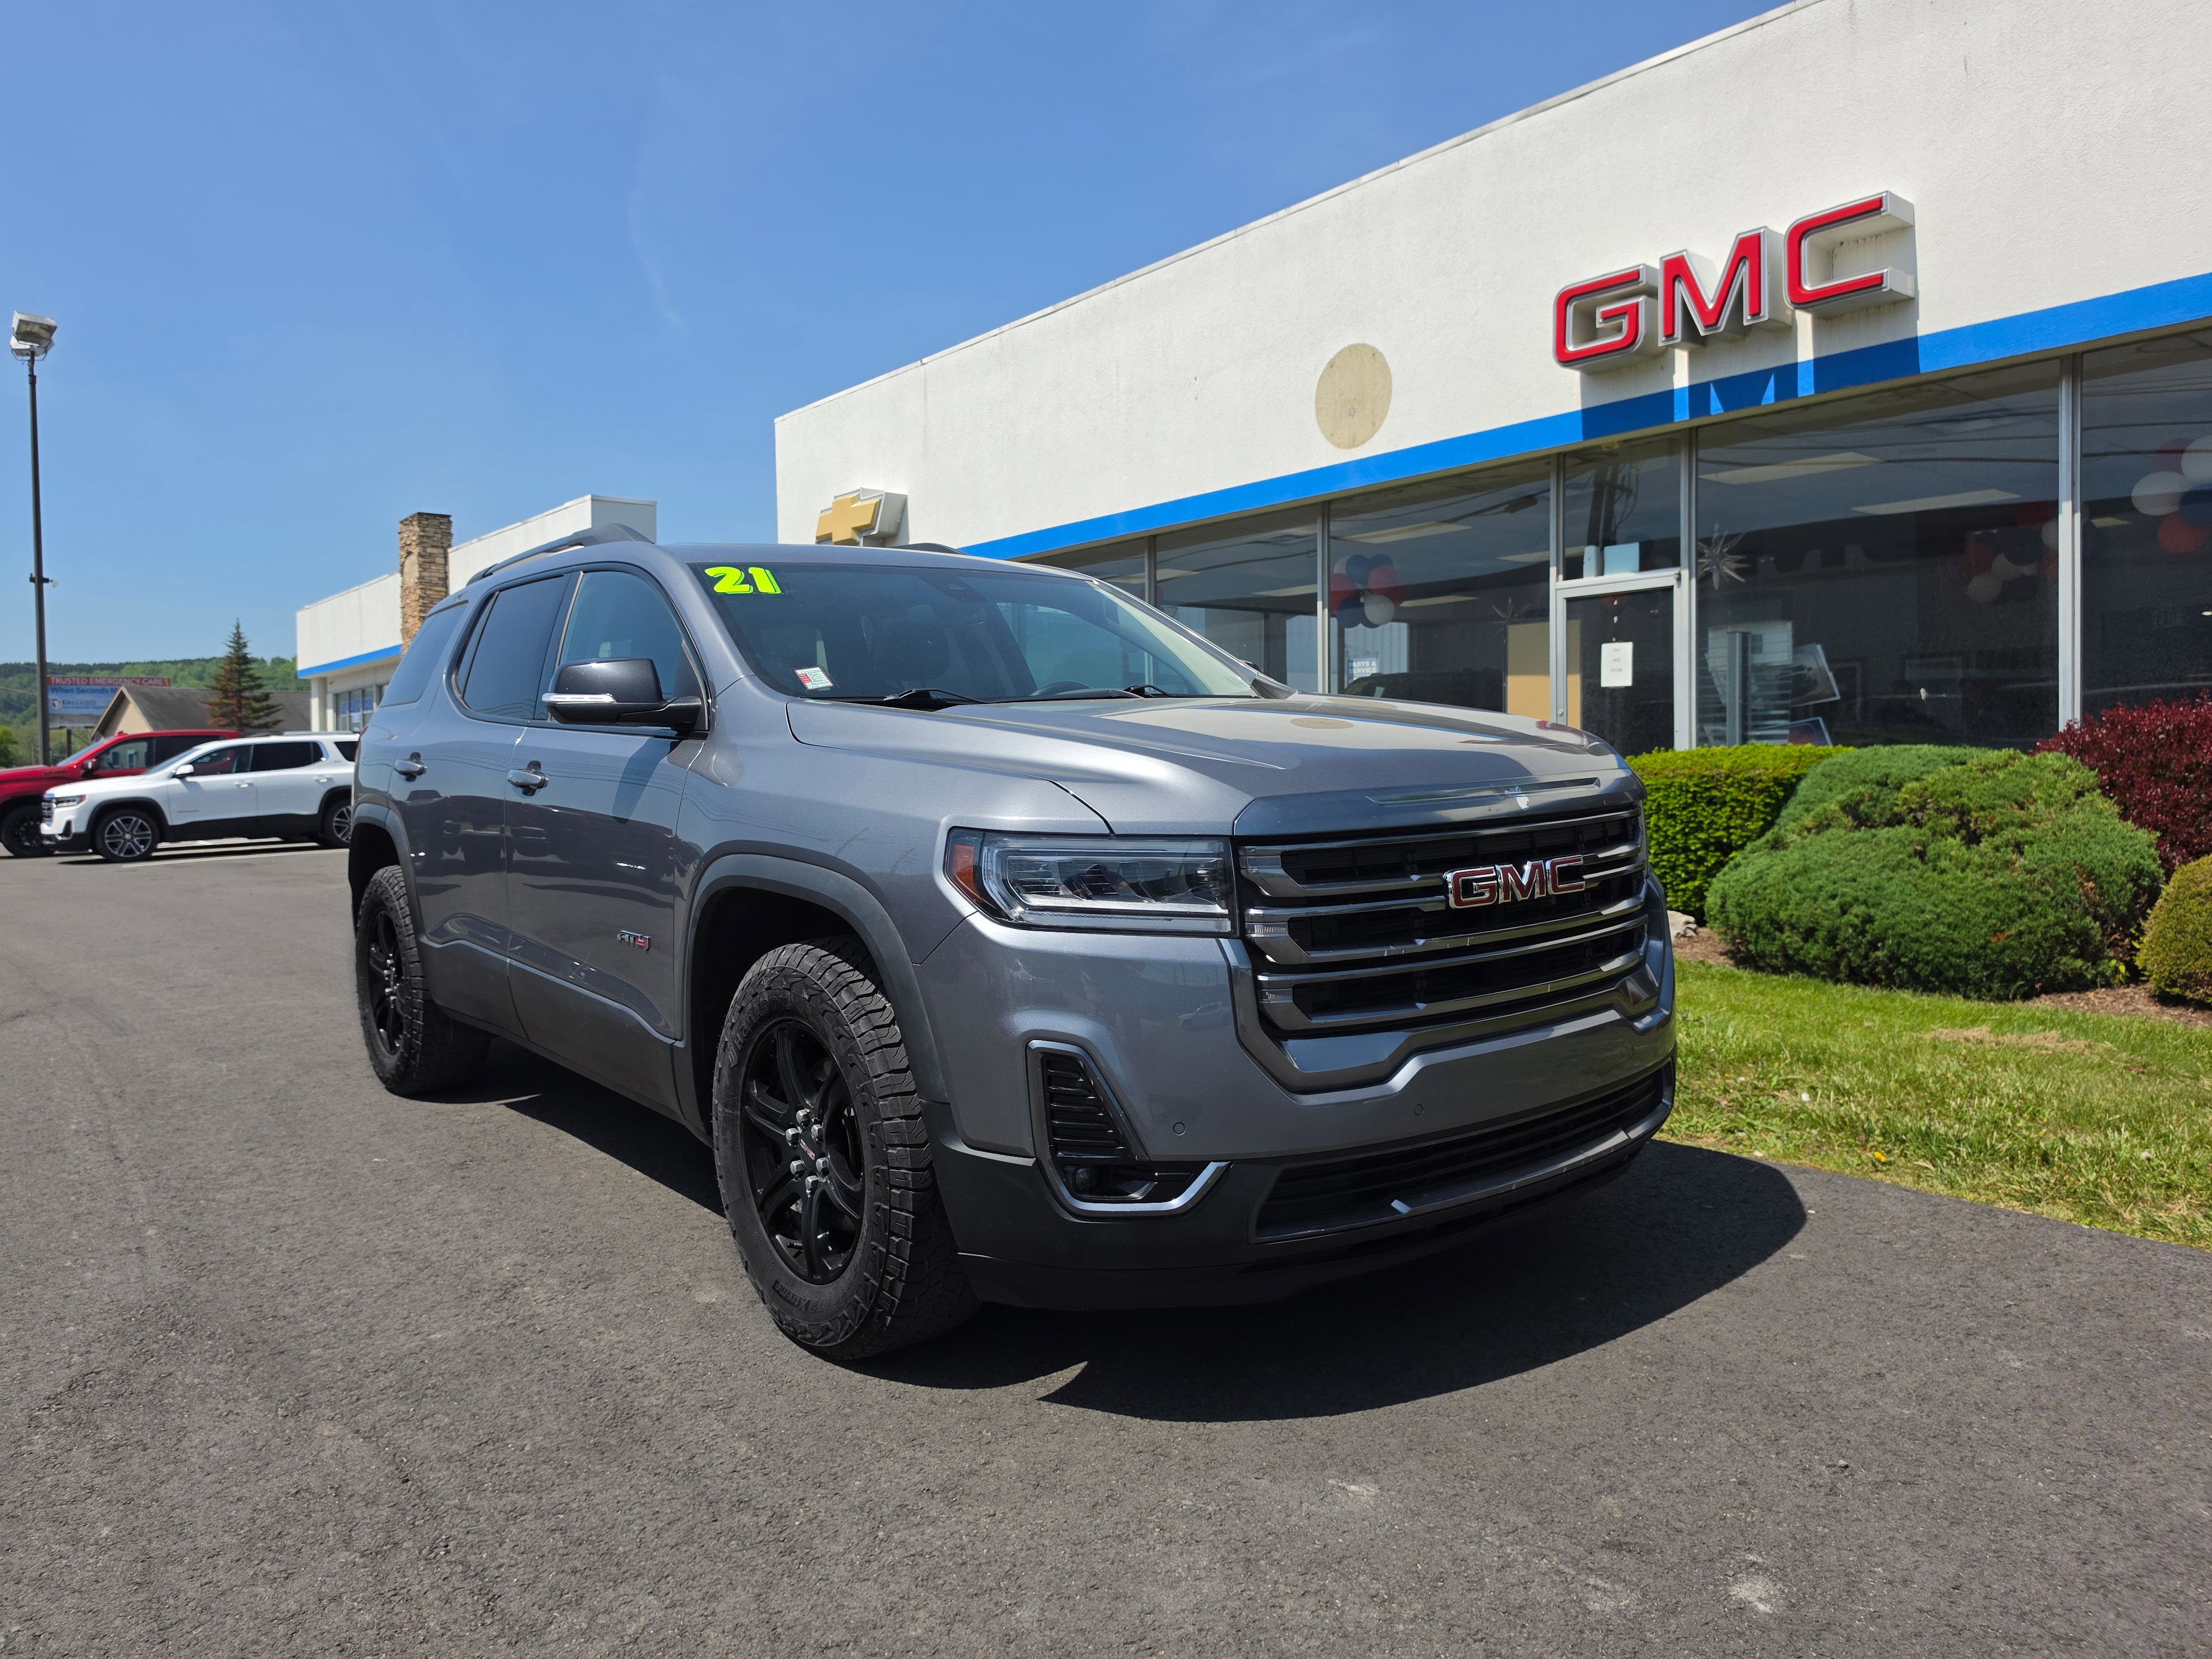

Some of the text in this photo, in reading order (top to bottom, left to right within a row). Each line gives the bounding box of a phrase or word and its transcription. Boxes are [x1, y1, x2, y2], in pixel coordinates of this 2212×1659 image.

[1553, 190, 1893, 368] GMC
[704, 566, 781, 594] 21
[50, 677, 164, 686] TRUSTED EMERGENCY CARE
[1443, 854, 1585, 909] GMC
